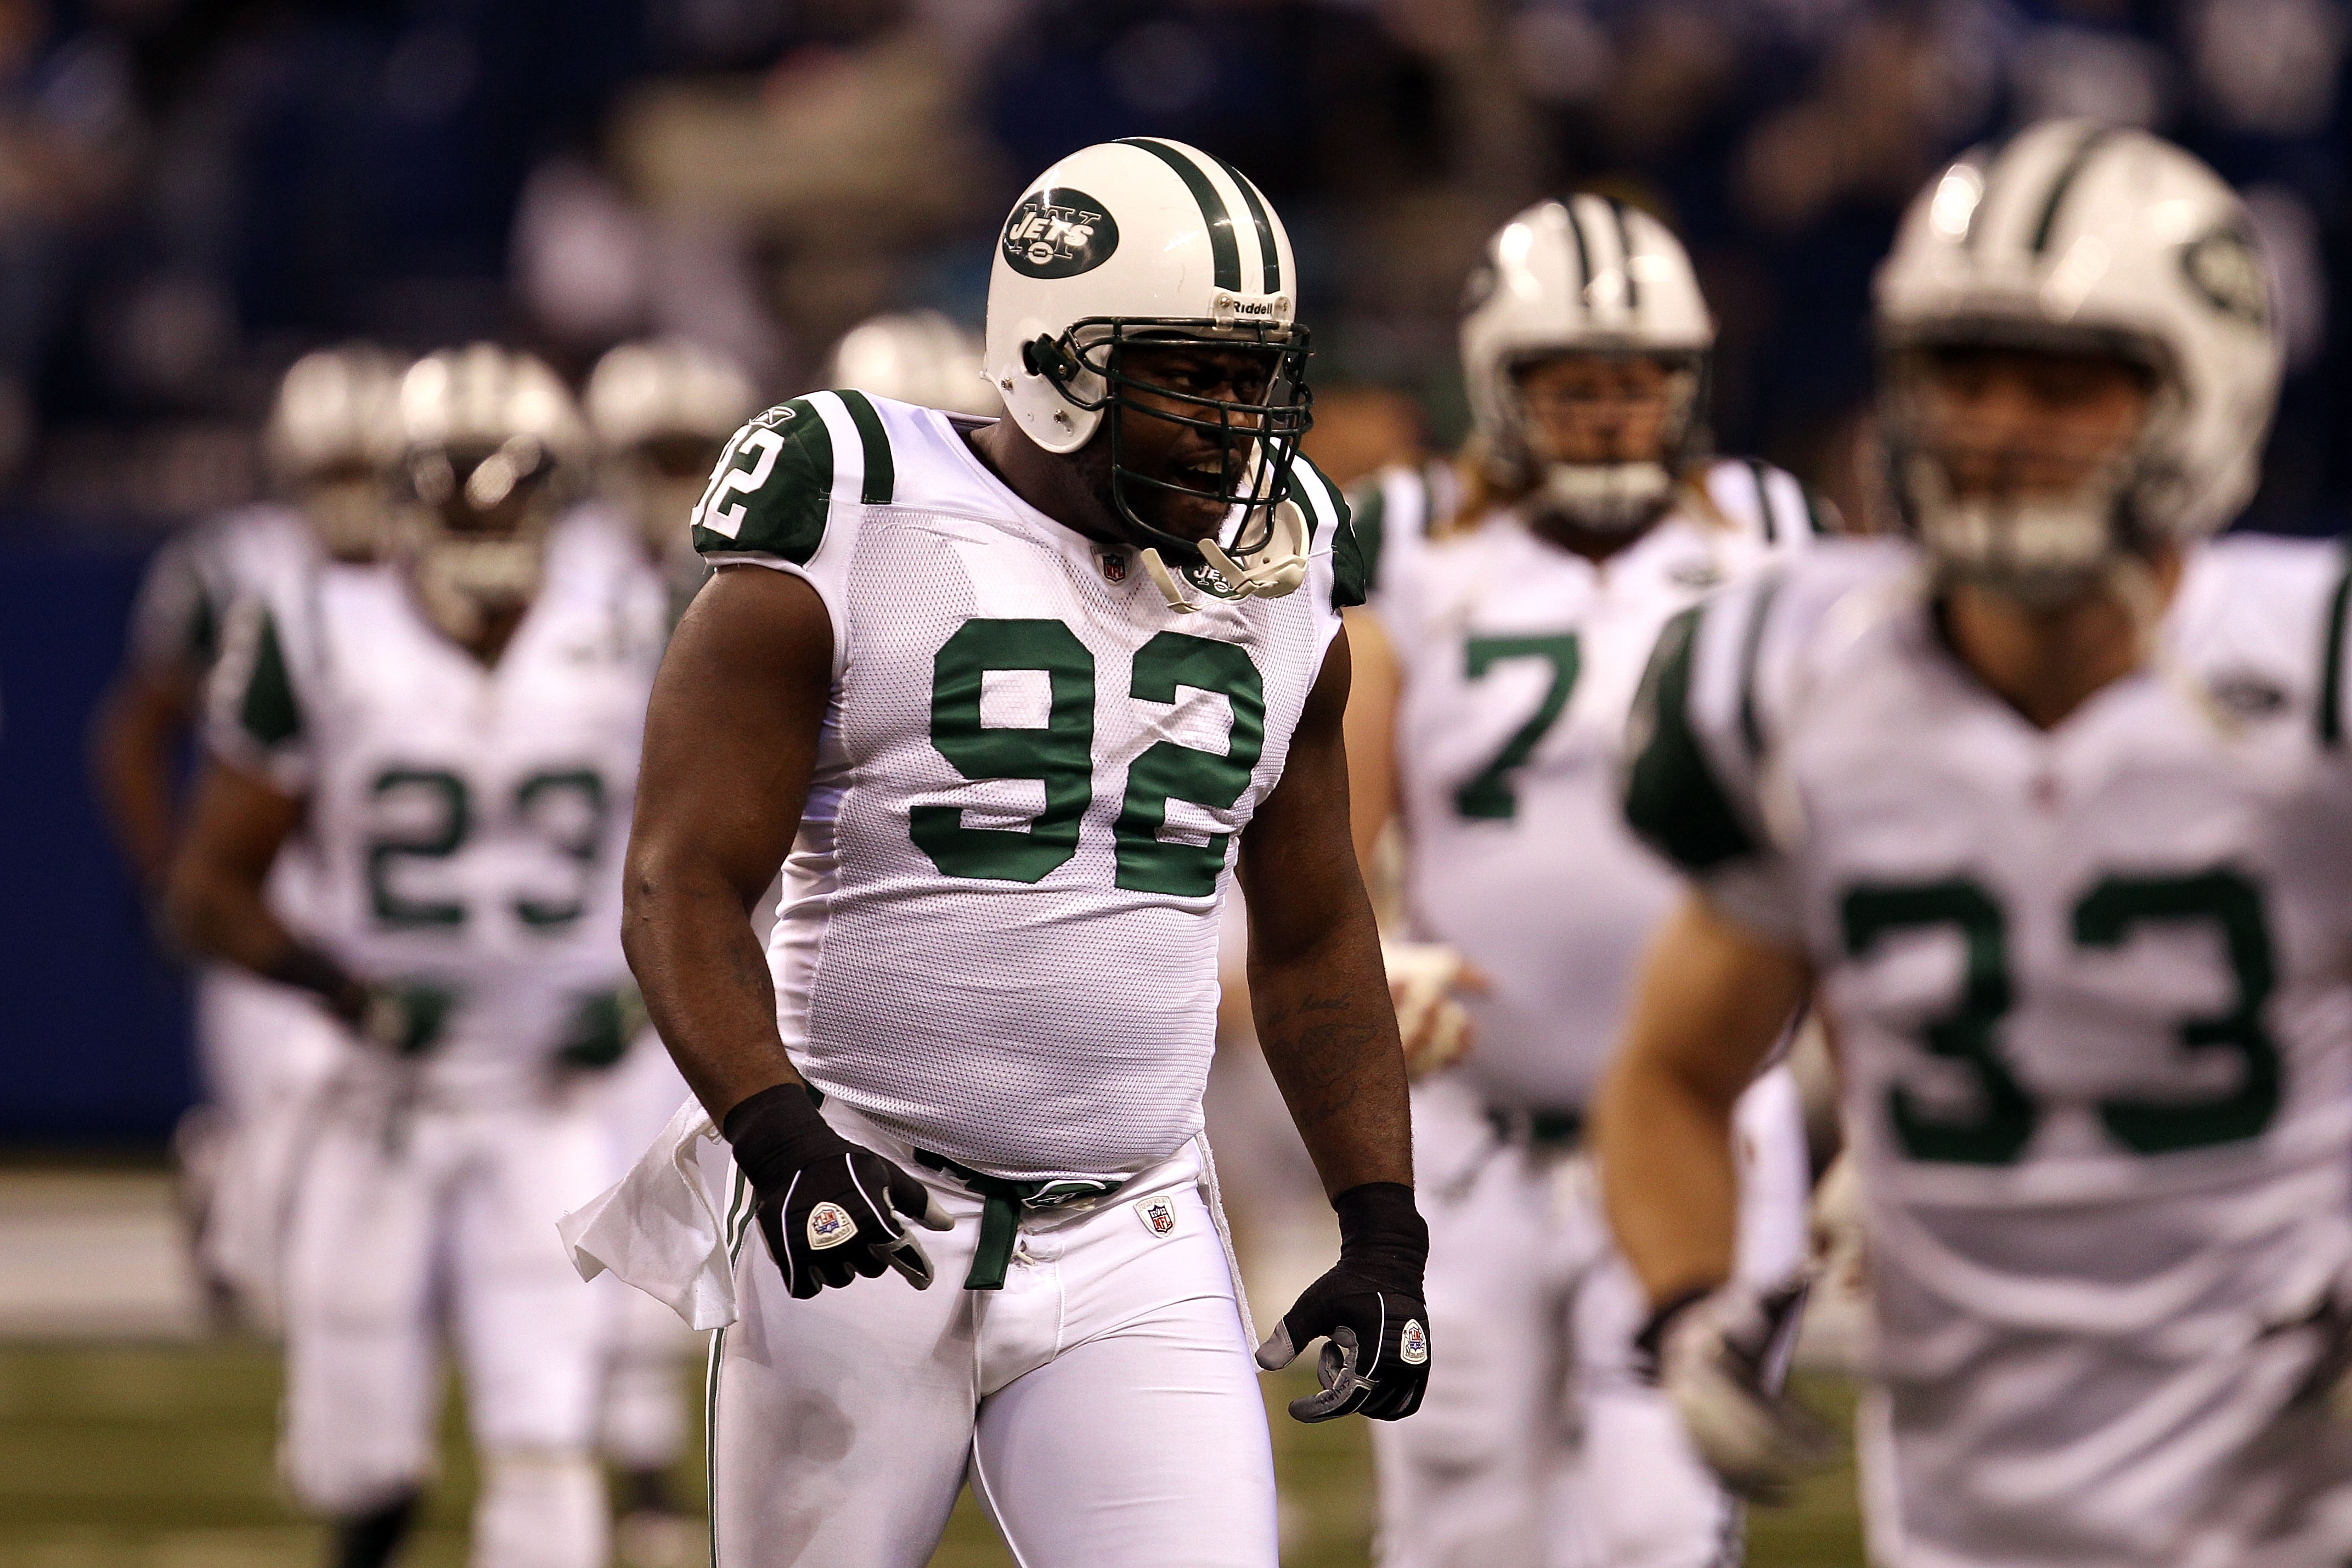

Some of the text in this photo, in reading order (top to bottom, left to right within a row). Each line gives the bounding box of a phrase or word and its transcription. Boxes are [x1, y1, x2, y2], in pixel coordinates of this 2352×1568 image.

[1009, 211, 1094, 246] JETS
[1234, 301, 1273, 314] Riddell
[909, 618, 1266, 897] 92
[1455, 633, 1580, 821] 7
[369, 768, 606, 928] 23
[1841, 868, 2278, 1166] 33
[1153, 1215, 1171, 1229] NFL
